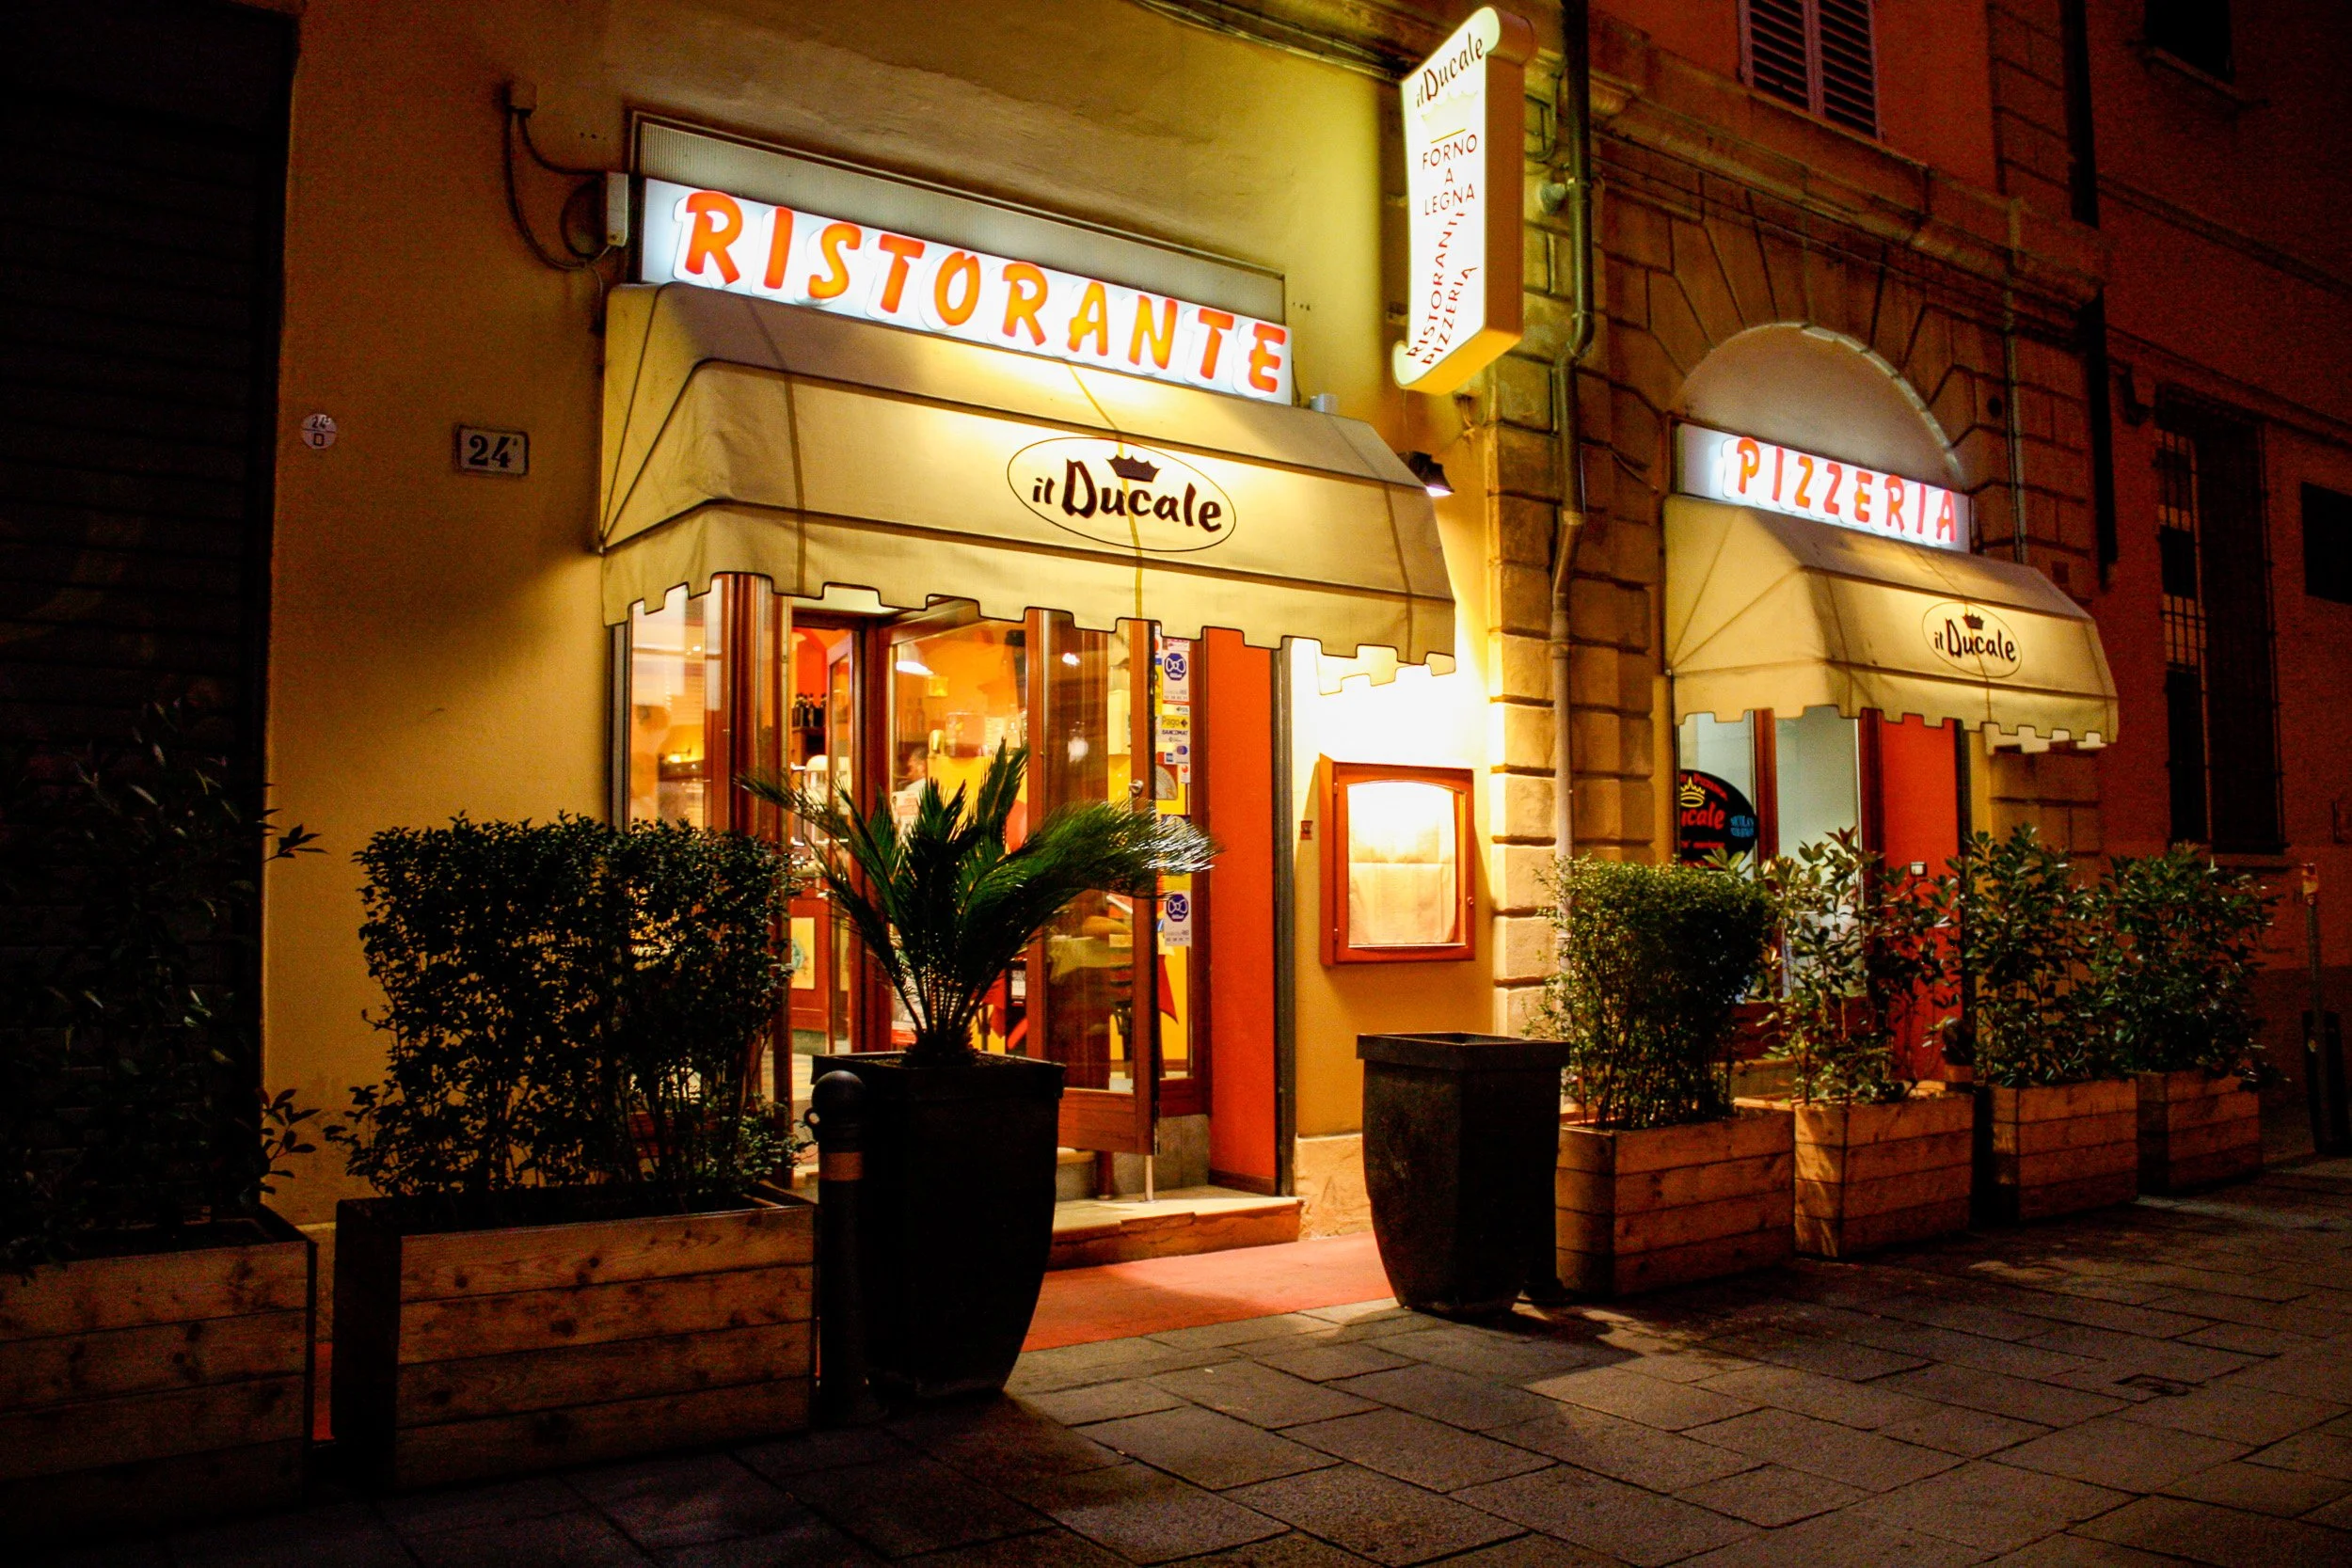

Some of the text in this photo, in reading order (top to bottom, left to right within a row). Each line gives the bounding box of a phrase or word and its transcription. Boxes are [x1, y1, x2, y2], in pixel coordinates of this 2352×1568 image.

[1416, 31, 1485, 108] il Ducale
[1422, 134, 1477, 170] FORNO
[1444, 167, 1454, 186] A
[1423, 182, 1475, 216] LEGNA
[684, 190, 1287, 393] RISTORANTE
[1421, 266, 1479, 365] PIZZERIA
[1032, 458, 1222, 533] il Ducale
[1736, 436, 1958, 543] PIZZERIA
[1934, 616, 2016, 663] il Ducale
